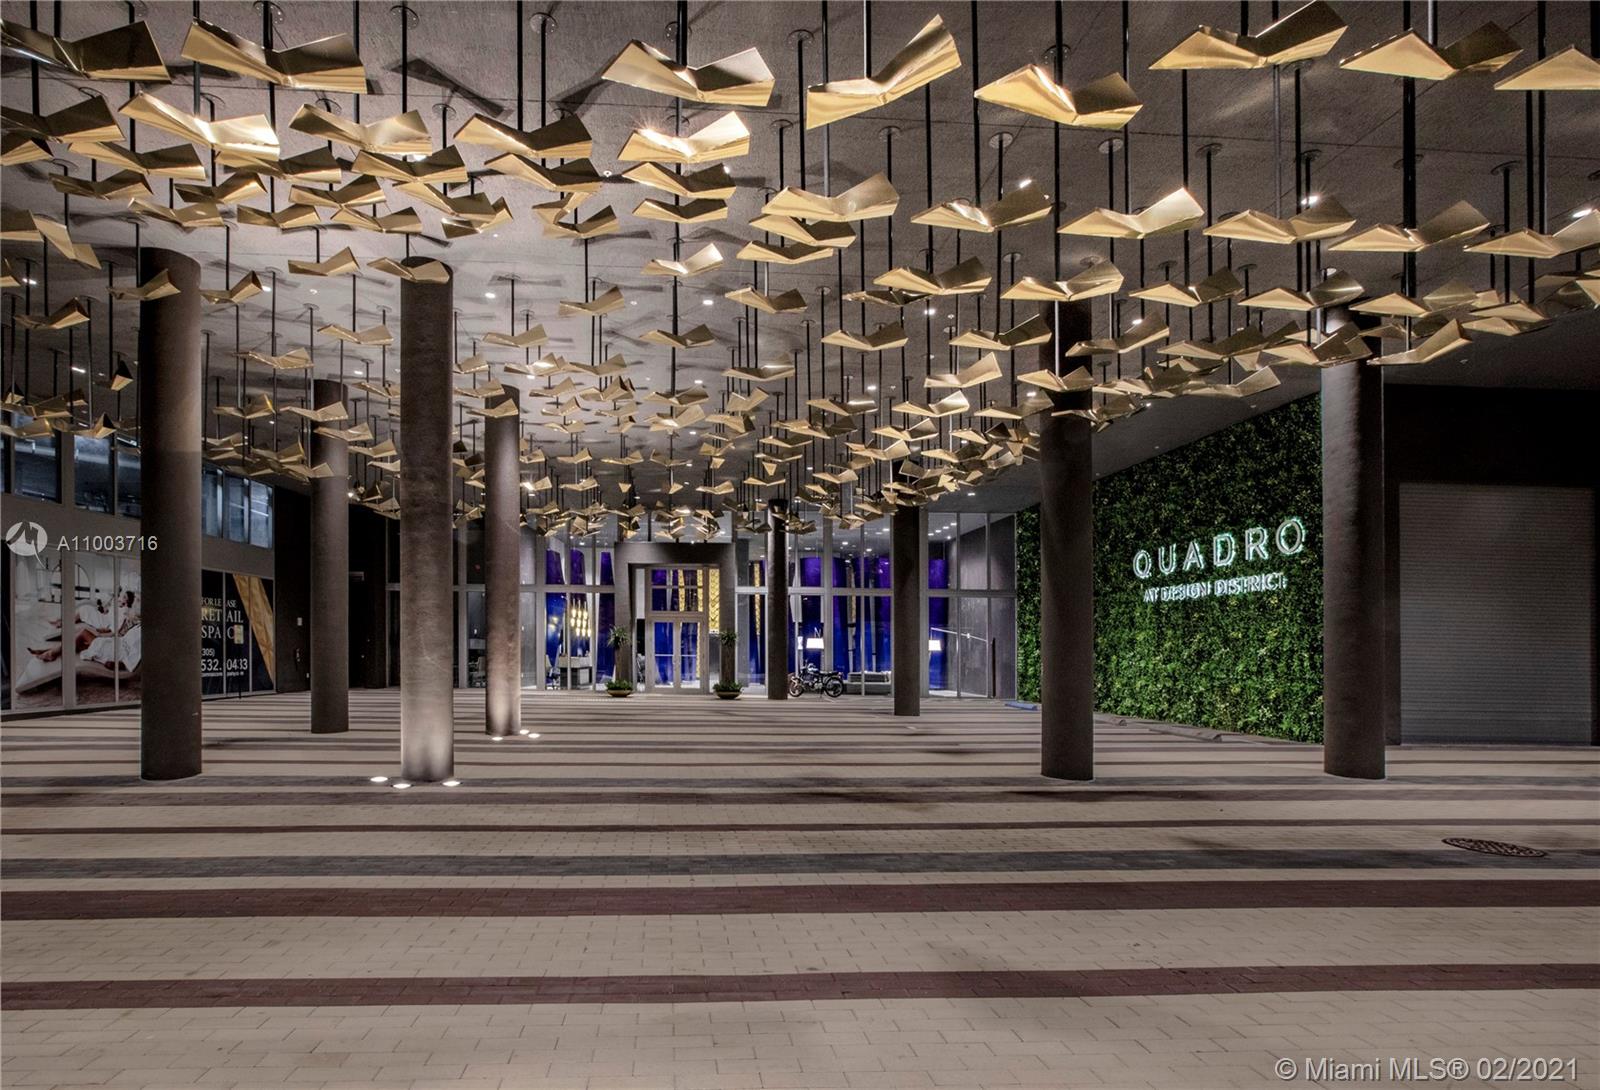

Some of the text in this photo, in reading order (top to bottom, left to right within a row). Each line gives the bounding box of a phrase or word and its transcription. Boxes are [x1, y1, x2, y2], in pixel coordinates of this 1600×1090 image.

[1132, 516, 1307, 579] QUADRO
[1143, 571, 1287, 602] AT DESIGN DISTRICT
[215, 598, 237, 608] LEASE
[201, 608, 243, 623] RETAIL
[201, 625, 243, 639] SPAC
[201, 648, 215, 657] 305)
